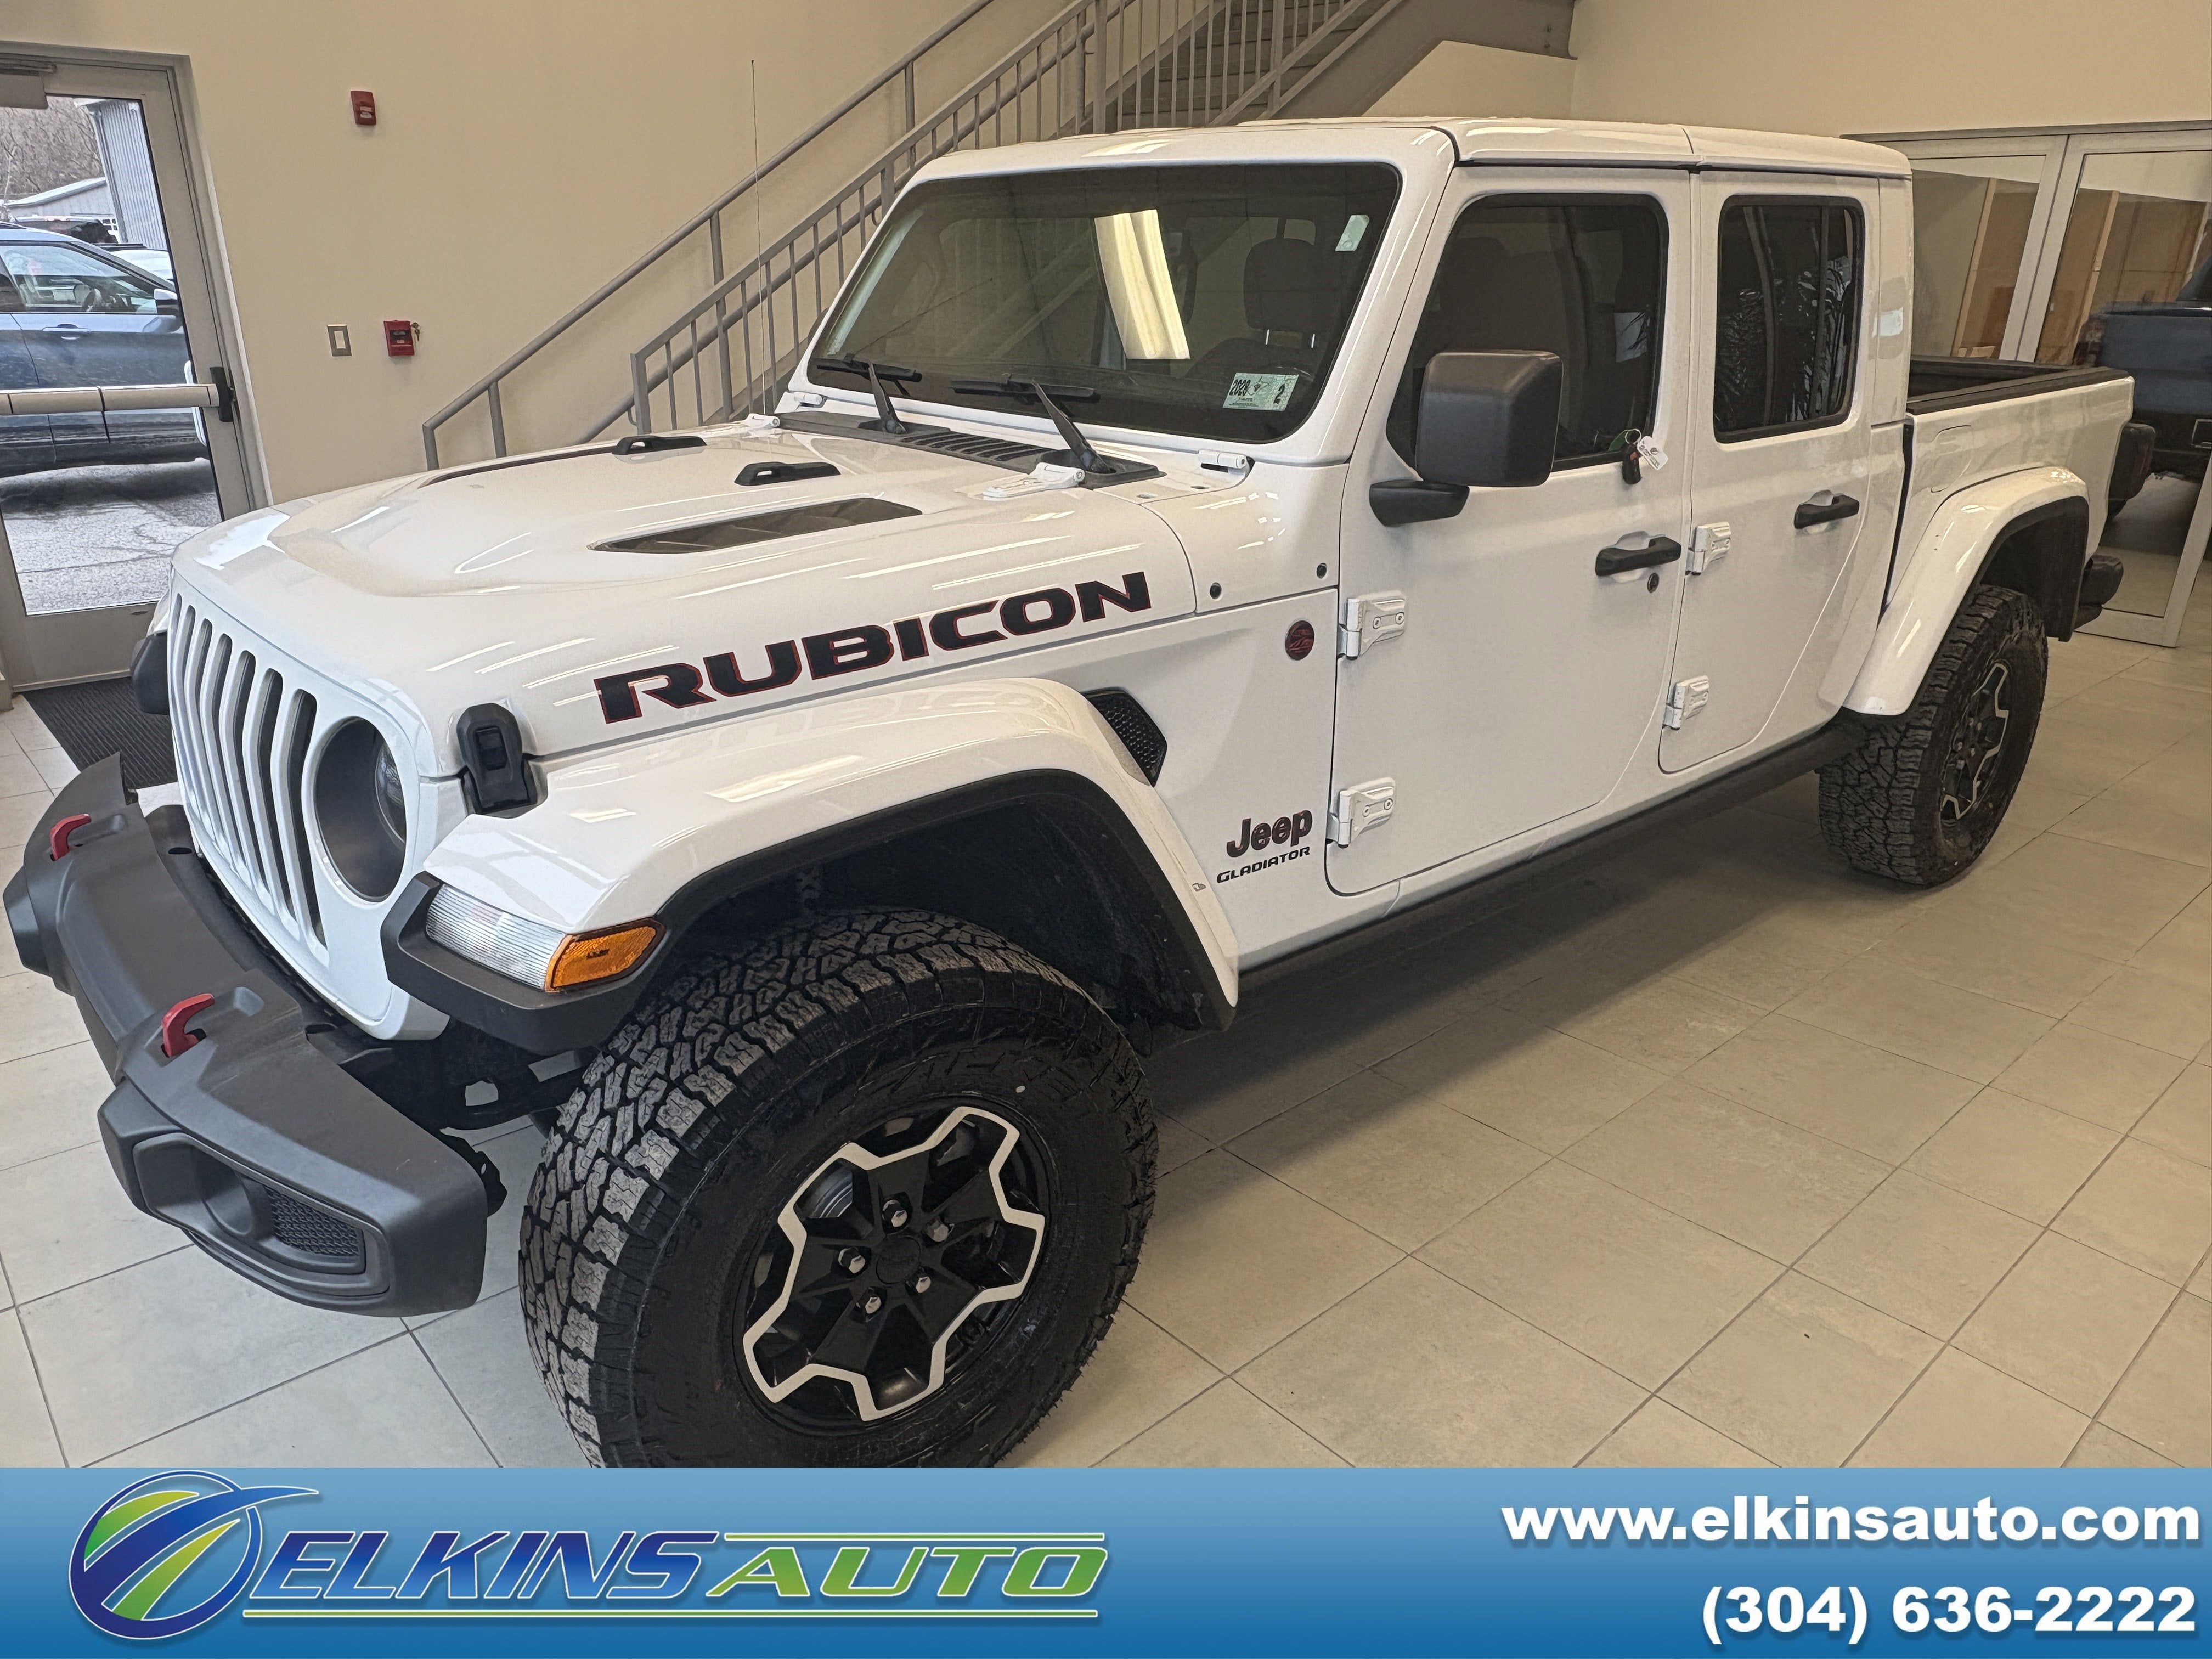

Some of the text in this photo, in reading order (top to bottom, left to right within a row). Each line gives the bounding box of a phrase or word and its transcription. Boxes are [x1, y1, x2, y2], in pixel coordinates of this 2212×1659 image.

[1273, 383, 1285, 404] 2
[593, 571, 1153, 725] RUBICON
[1226, 809, 1313, 859] Jeep
[1216, 845, 1311, 884] GLADIATOR
